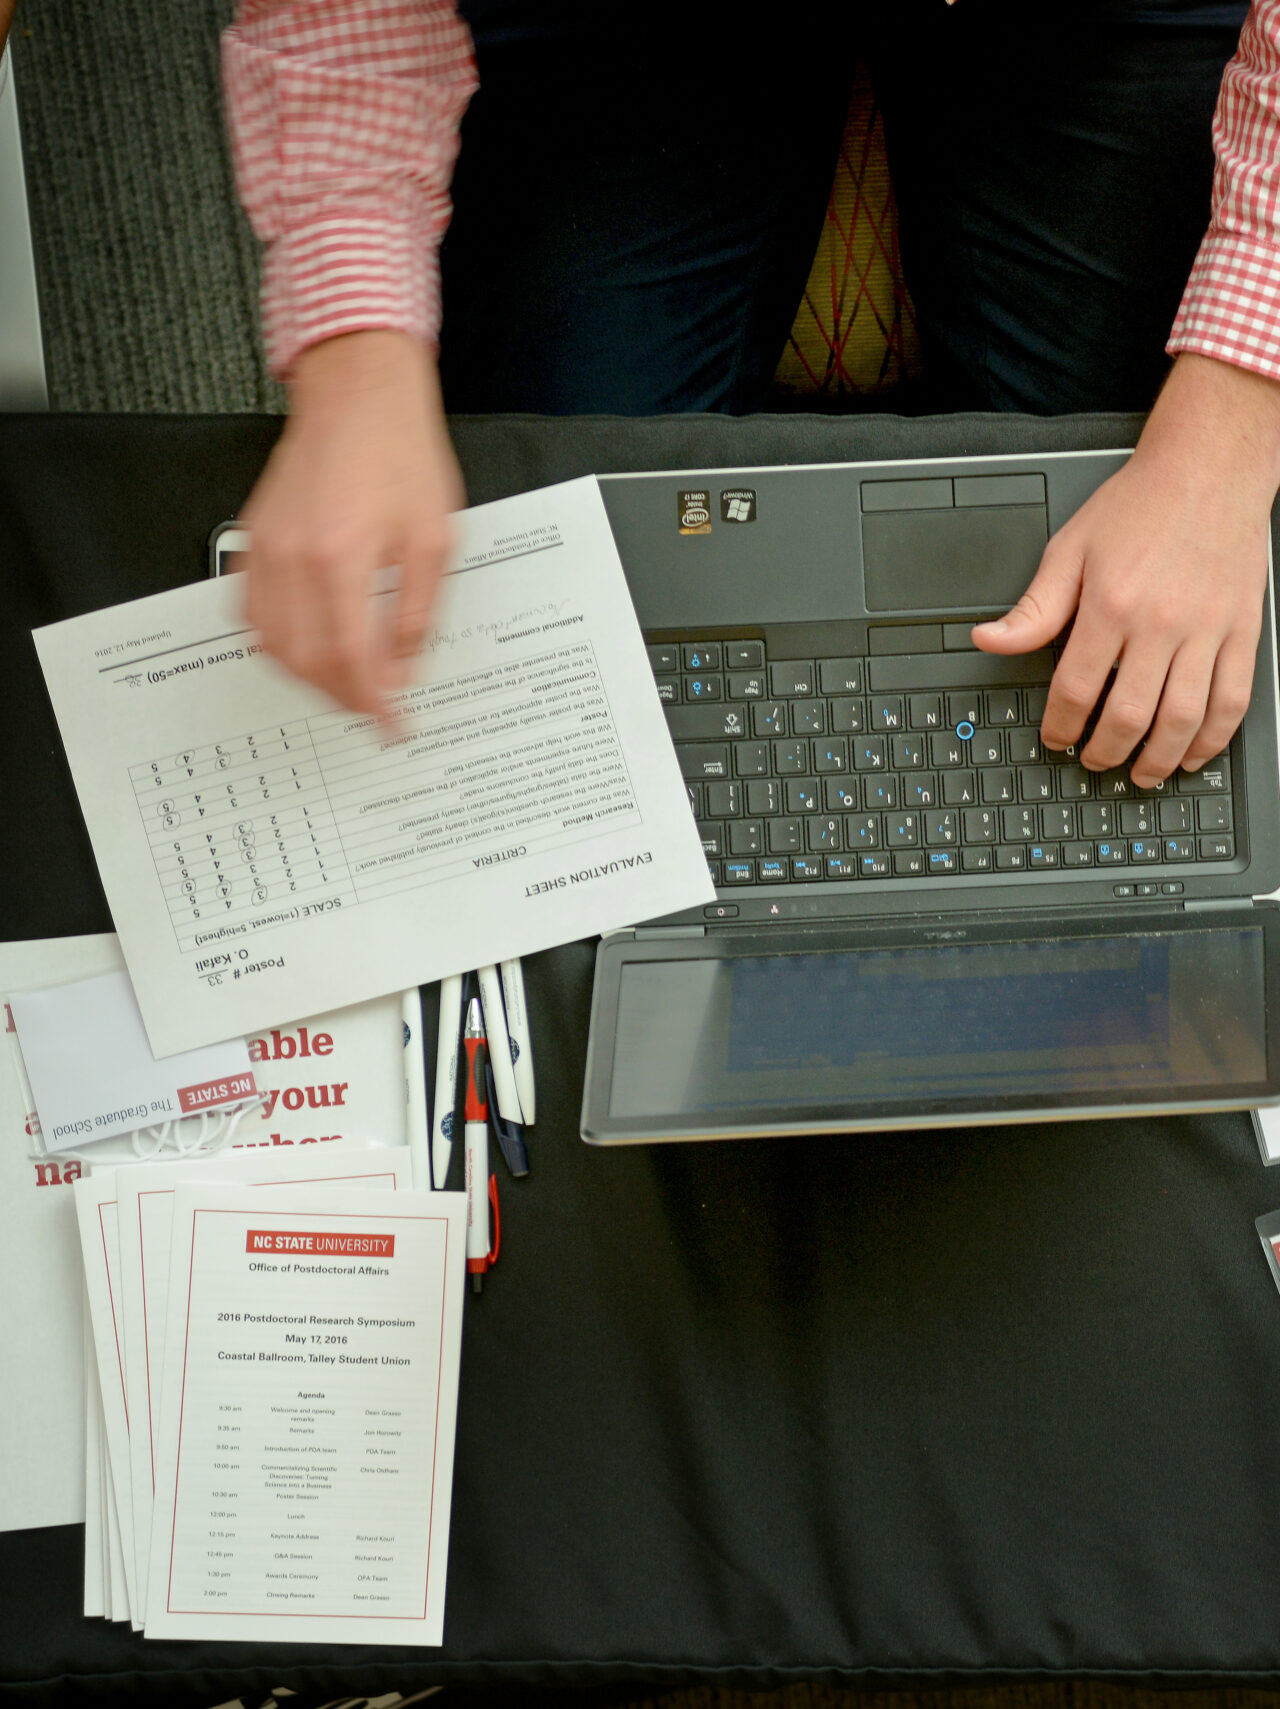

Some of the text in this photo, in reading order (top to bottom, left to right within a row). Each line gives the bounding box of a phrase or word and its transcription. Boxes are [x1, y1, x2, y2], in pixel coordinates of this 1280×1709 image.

[492, 523, 557, 546] NC State University
[463, 533, 560, 563] Office of Postdoctoral Affairs
[541, 614, 583, 632] Additional
[93, 630, 171, 656] Updated May 12, 2016
[146, 639, 268, 683] tal Score (max=50)
[530, 670, 596, 693] Communication
[794, 683, 807, 691] Ctrl
[845, 680, 855, 688] Alt
[580, 710, 607, 722] Poster
[724, 724, 740, 733] Shift
[704, 764, 723, 773] Enter
[561, 801, 633, 827] Research Method
[471, 845, 526, 867] CRITERIA
[1215, 845, 1226, 855] Esc
[525, 851, 652, 897] EVALUATION SHEET
[194, 897, 341, 946] SCALE (1=lowest, 5=highest)
[194, 948, 248, 971] O. Kafali
[233, 956, 284, 979] Poster #
[206, 972, 222, 986] 33
[247, 1026, 333, 1062] able
[187, 1078, 251, 1105] NC STATE
[258, 1082, 348, 1119] your
[94, 1104, 148, 1126] Graduate
[149, 1098, 172, 1111] The
[52, 1119, 92, 1140] School
[253, 1235, 388, 1252] NC STATE UNIVERSITY
[248, 1262, 389, 1275] Office of Postdoctoral Affairs
[217, 1312, 415, 1328] 2016 Postdoctoral Research Symposium
[284, 1333, 347, 1344] May 17, 2016
[217, 1351, 410, 1365] Coastal Ballroom, Talley Student Union
[297, 1391, 325, 1399] Agenda
